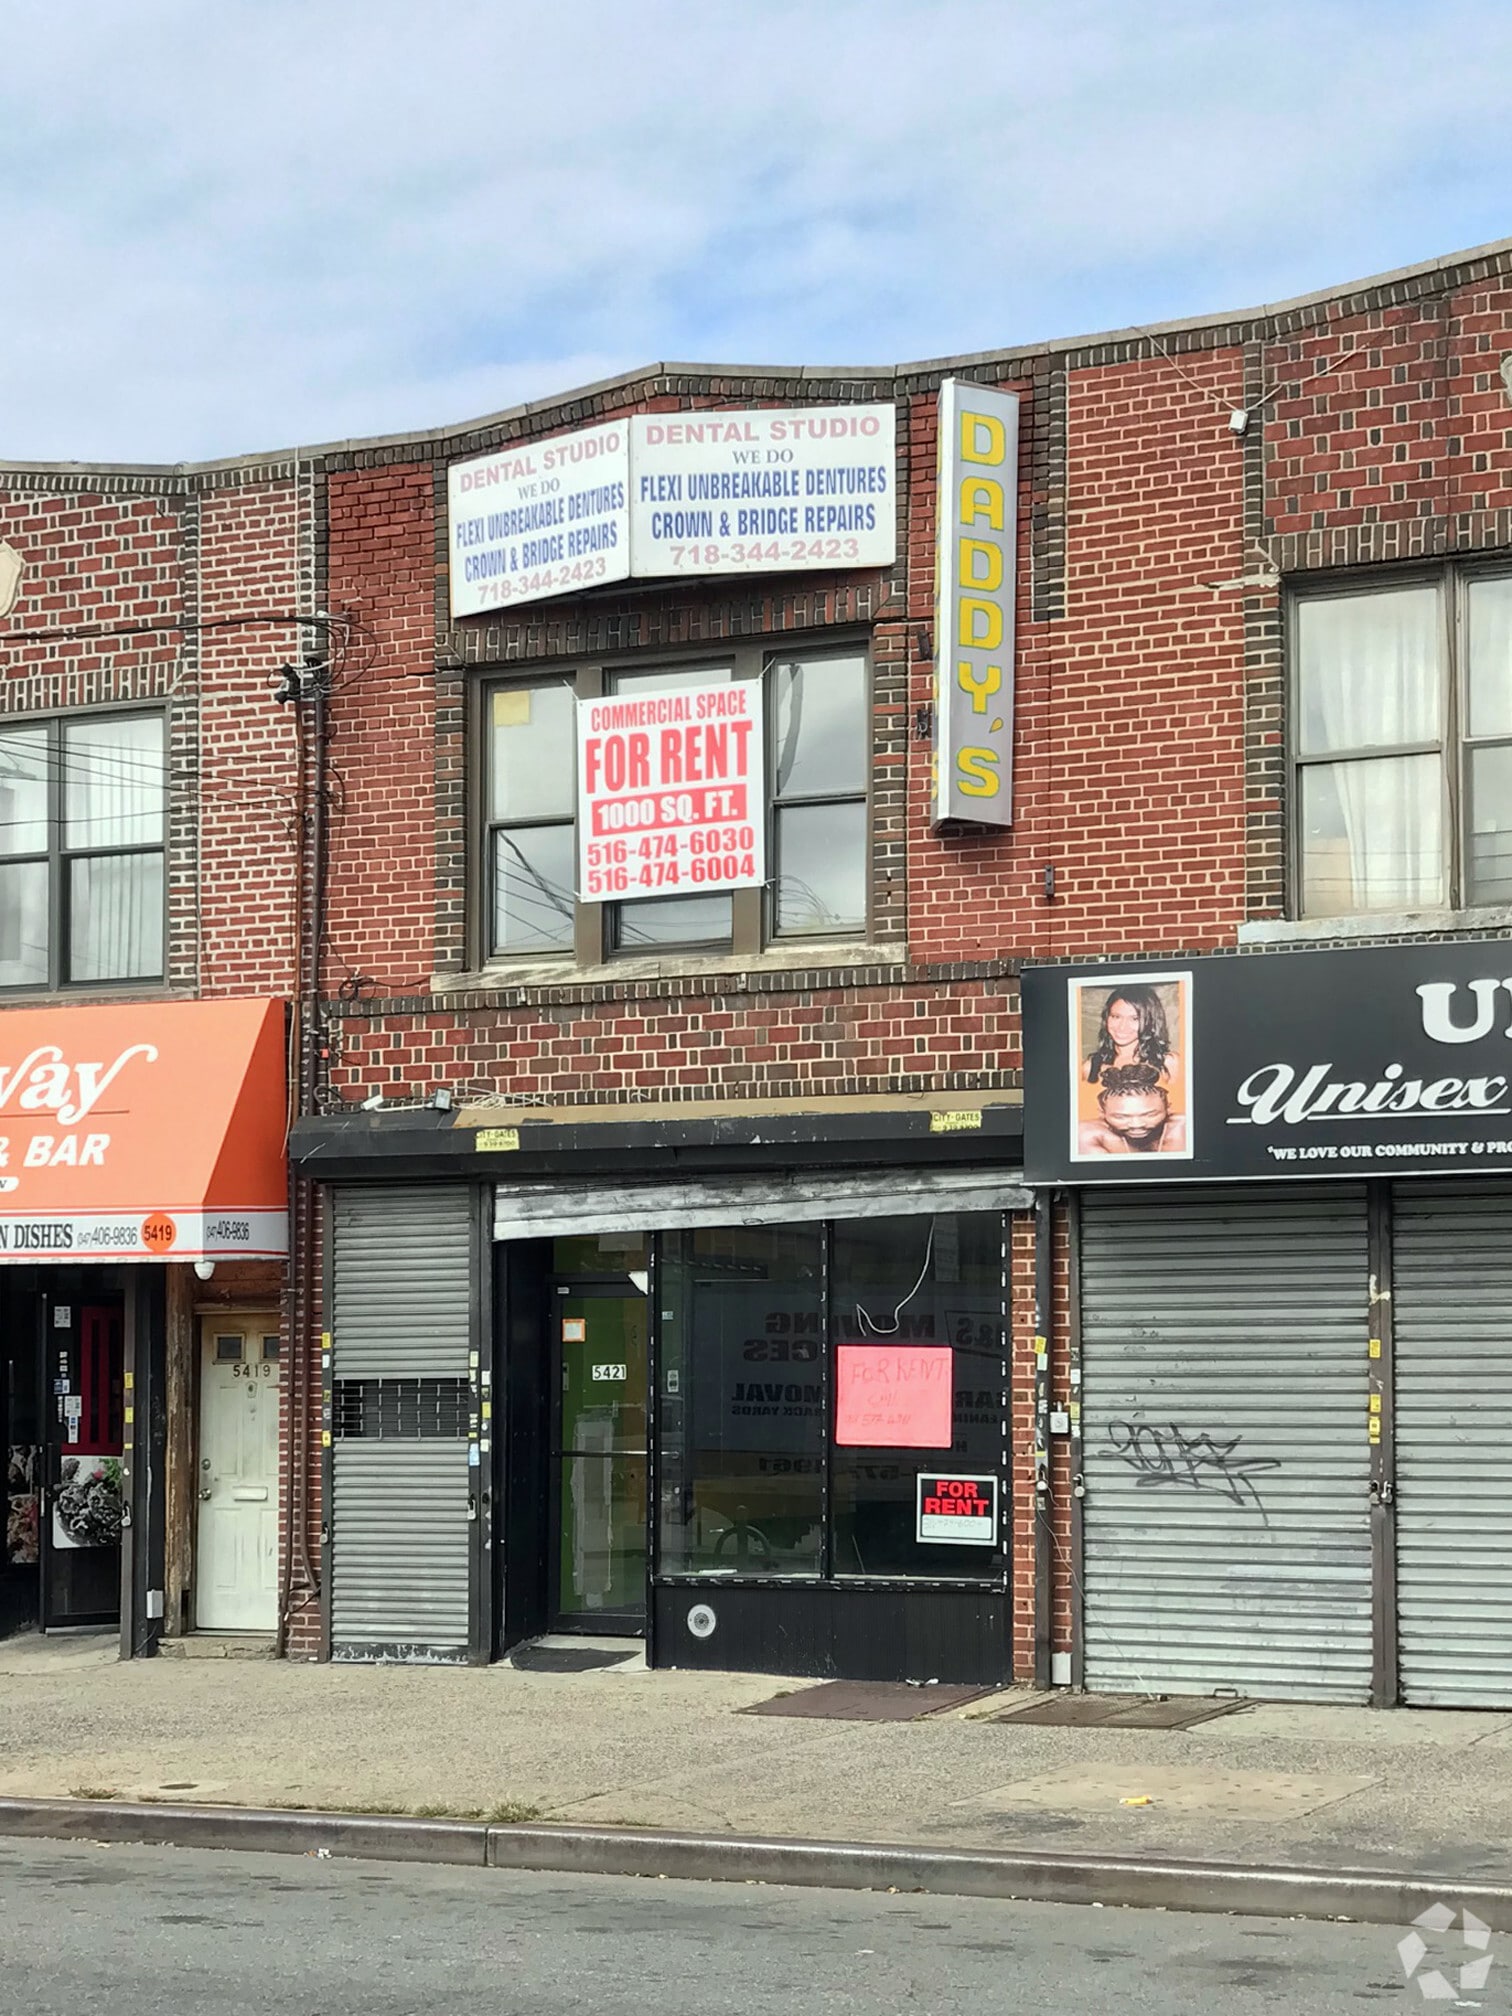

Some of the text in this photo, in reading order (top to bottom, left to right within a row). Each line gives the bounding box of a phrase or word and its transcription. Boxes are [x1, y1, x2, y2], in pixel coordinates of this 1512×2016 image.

[646, 416, 880, 445] DENTAL STUDIO
[460, 432, 620, 493] DENTAL STUDIO
[732, 449, 793, 464] WE DO
[517, 477, 560, 500] WE DO
[640, 466, 886, 502] FLEXI UNBREAKABLE DENTURES
[457, 481, 624, 549] FLEXI UNBREAKABLE DENTURES
[652, 503, 876, 540] CROWN & BRIDGE REPAIRS
[465, 519, 617, 583] CROWN & BRIDGE REPAIRS
[670, 538, 859, 566] 718-344-2423
[477, 556, 606, 605] 718-344-2423
[957, 409, 1006, 798] DADDY'S
[591, 689, 746, 732] COMMERCIAL SPACE
[585, 720, 753, 794] FOR RENT
[598, 790, 738, 831] 1000 SQ. FT.
[587, 826, 754, 866] 516-474-6030
[587, 854, 755, 894] 516-474-6004
[1237, 1063, 1509, 1125] Unisex
[23, 1133, 111, 1168] BAR
[1300, 1146, 1338, 1159] LOVE
[1340, 1145, 1373, 1158] OUR
[1375, 1142, 1469, 1157] COMMUNITY
[1471, 1141, 1485, 1154] &
[14, 1223, 73, 1249] DISHES
[143, 1225, 172, 1241] 5419
[233, 1364, 271, 1378] 5419
[594, 1366, 627, 1379] 5421
[924, 1497, 990, 1516] RENT
[936, 1480, 978, 1498] FOR
